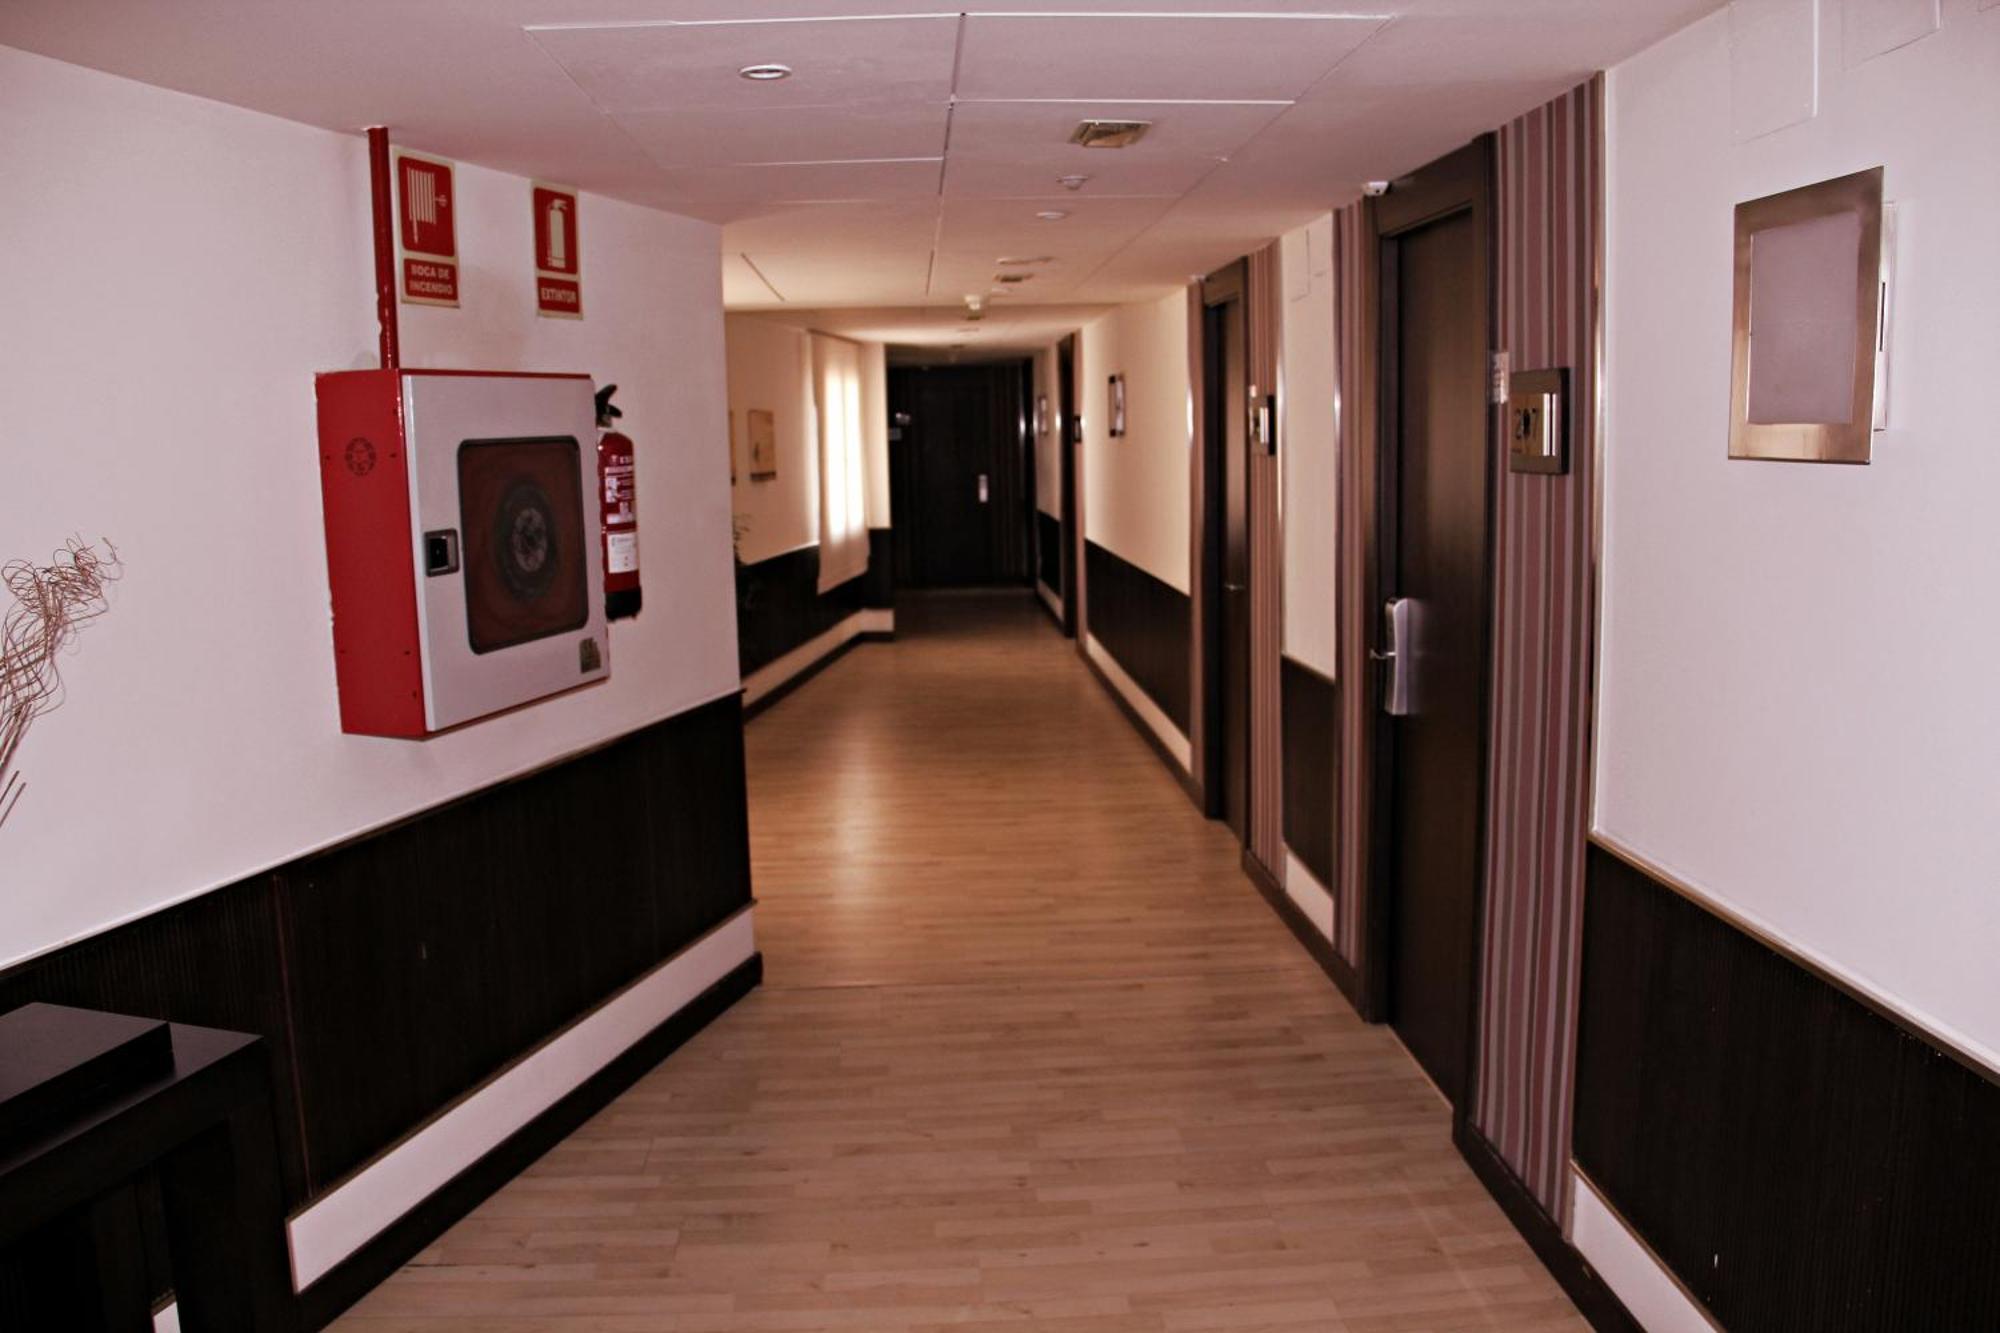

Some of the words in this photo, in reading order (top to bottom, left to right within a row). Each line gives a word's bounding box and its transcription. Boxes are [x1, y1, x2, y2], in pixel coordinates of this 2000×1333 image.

[412, 264, 436, 278] BOCA
[438, 268, 450, 280] DE
[409, 279, 453, 295] INCENDIO
[541, 288, 577, 303] EXTINTOR
